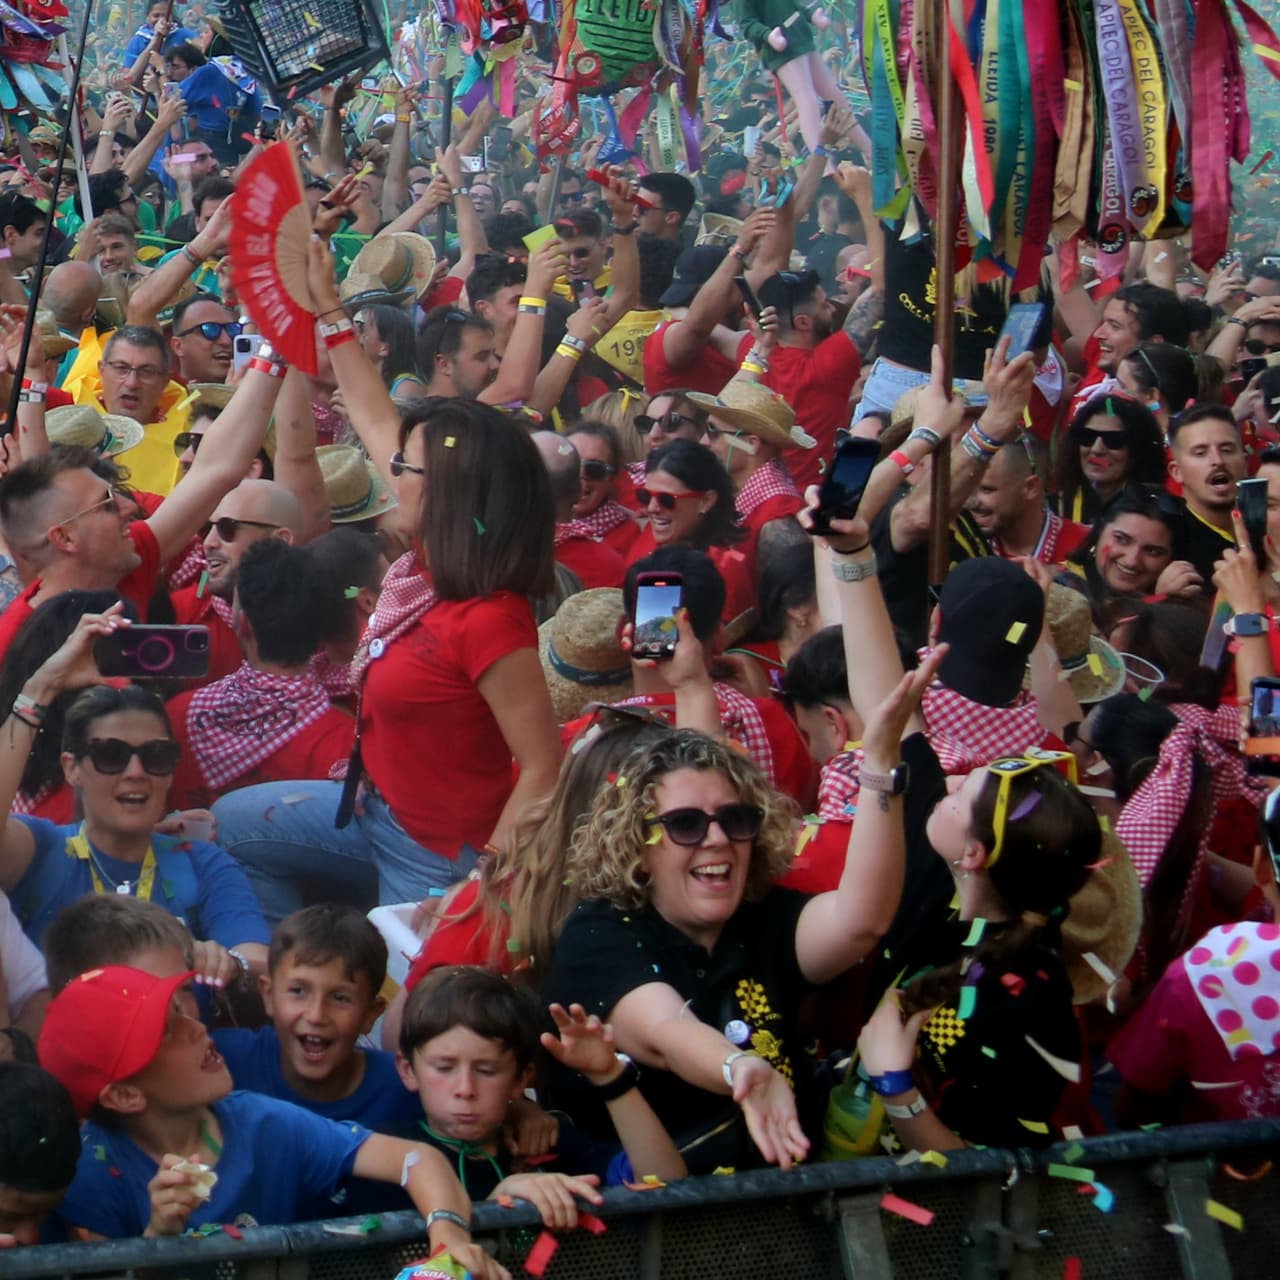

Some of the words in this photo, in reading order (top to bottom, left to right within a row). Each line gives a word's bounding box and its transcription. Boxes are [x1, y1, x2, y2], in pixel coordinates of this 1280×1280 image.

[1096, 2, 1120, 52] APLEC
[1122, 5, 1148, 52] APLEC
[1139, 56, 1154, 85] DEL
[983, 50, 999, 104] LLEIDA
[1104, 57, 1125, 82] DEL
[1110, 87, 1139, 166] CARAGOL
[898, 292, 932, 324] COLLA
